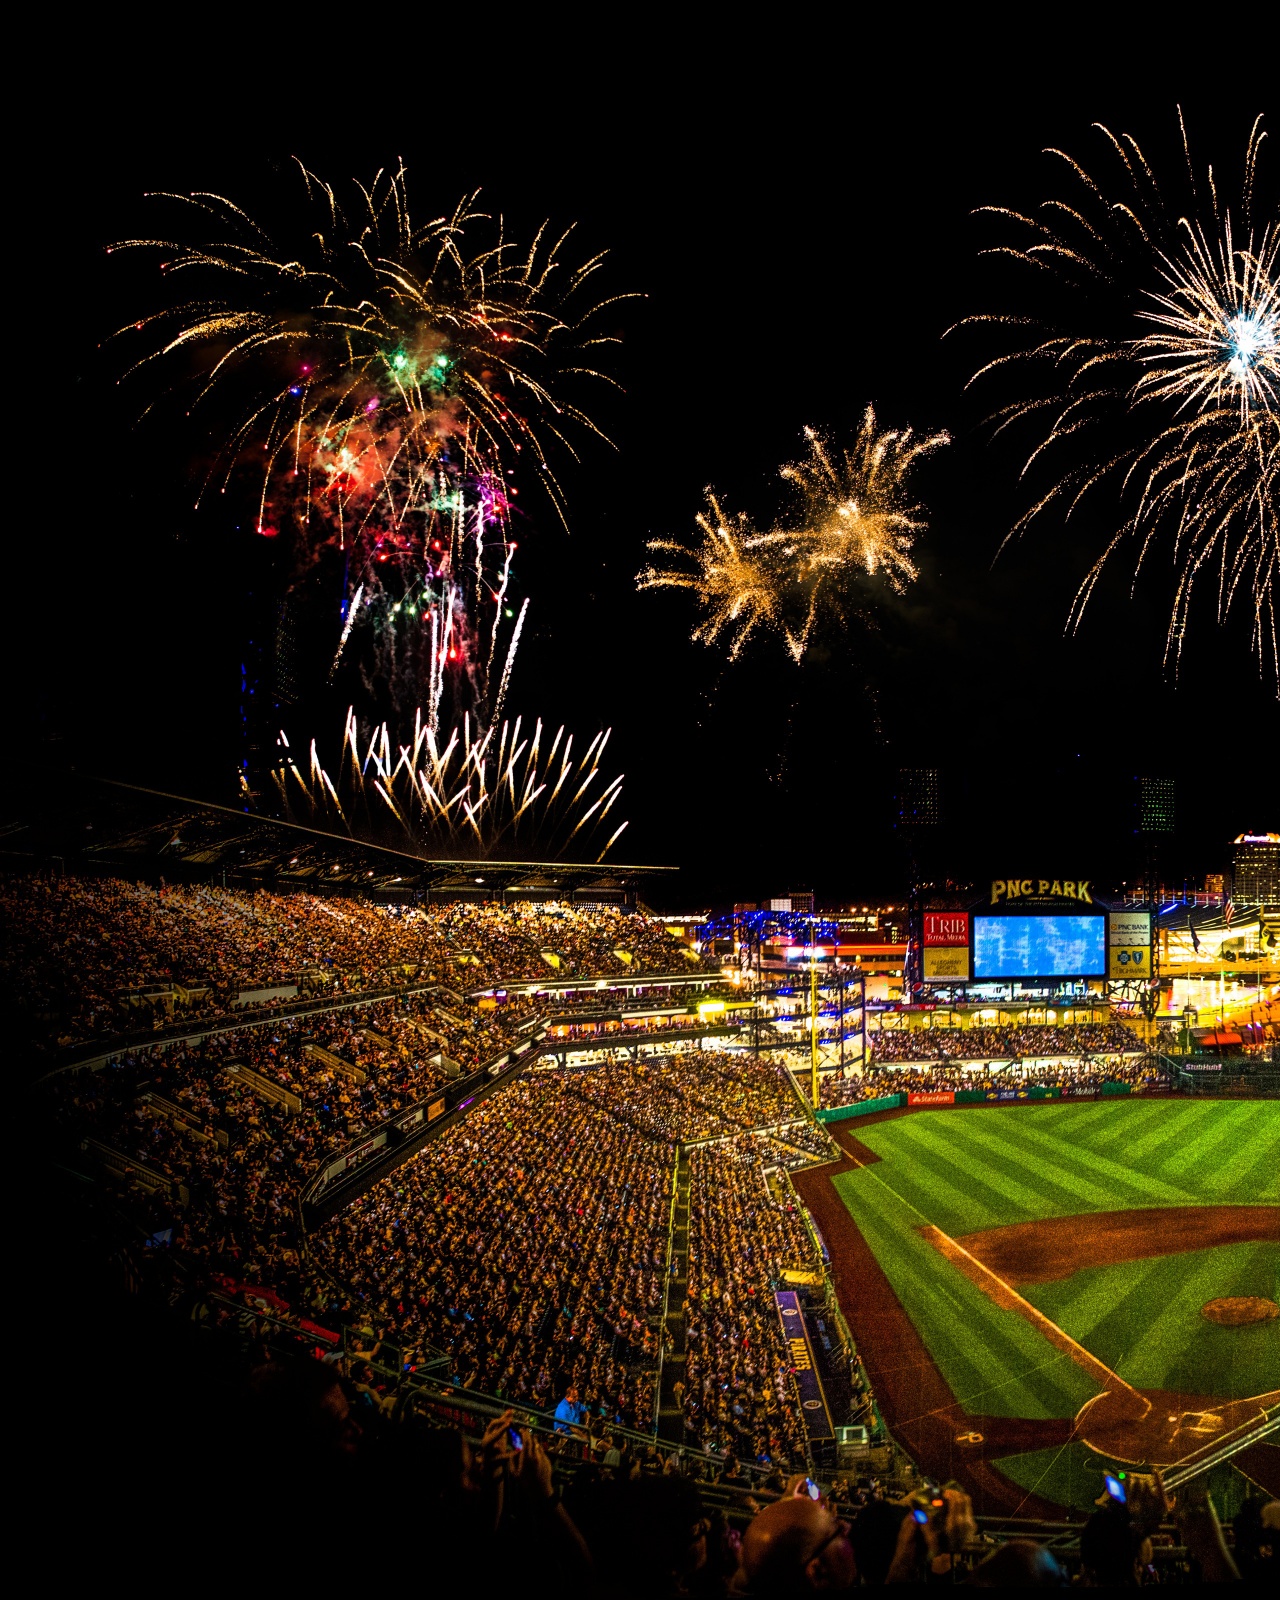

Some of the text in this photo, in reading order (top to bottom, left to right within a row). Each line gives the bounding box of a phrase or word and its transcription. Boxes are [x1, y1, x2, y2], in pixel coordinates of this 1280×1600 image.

[990, 879, 1093, 905] PNC PARK
[925, 916, 966, 933] TRIB
